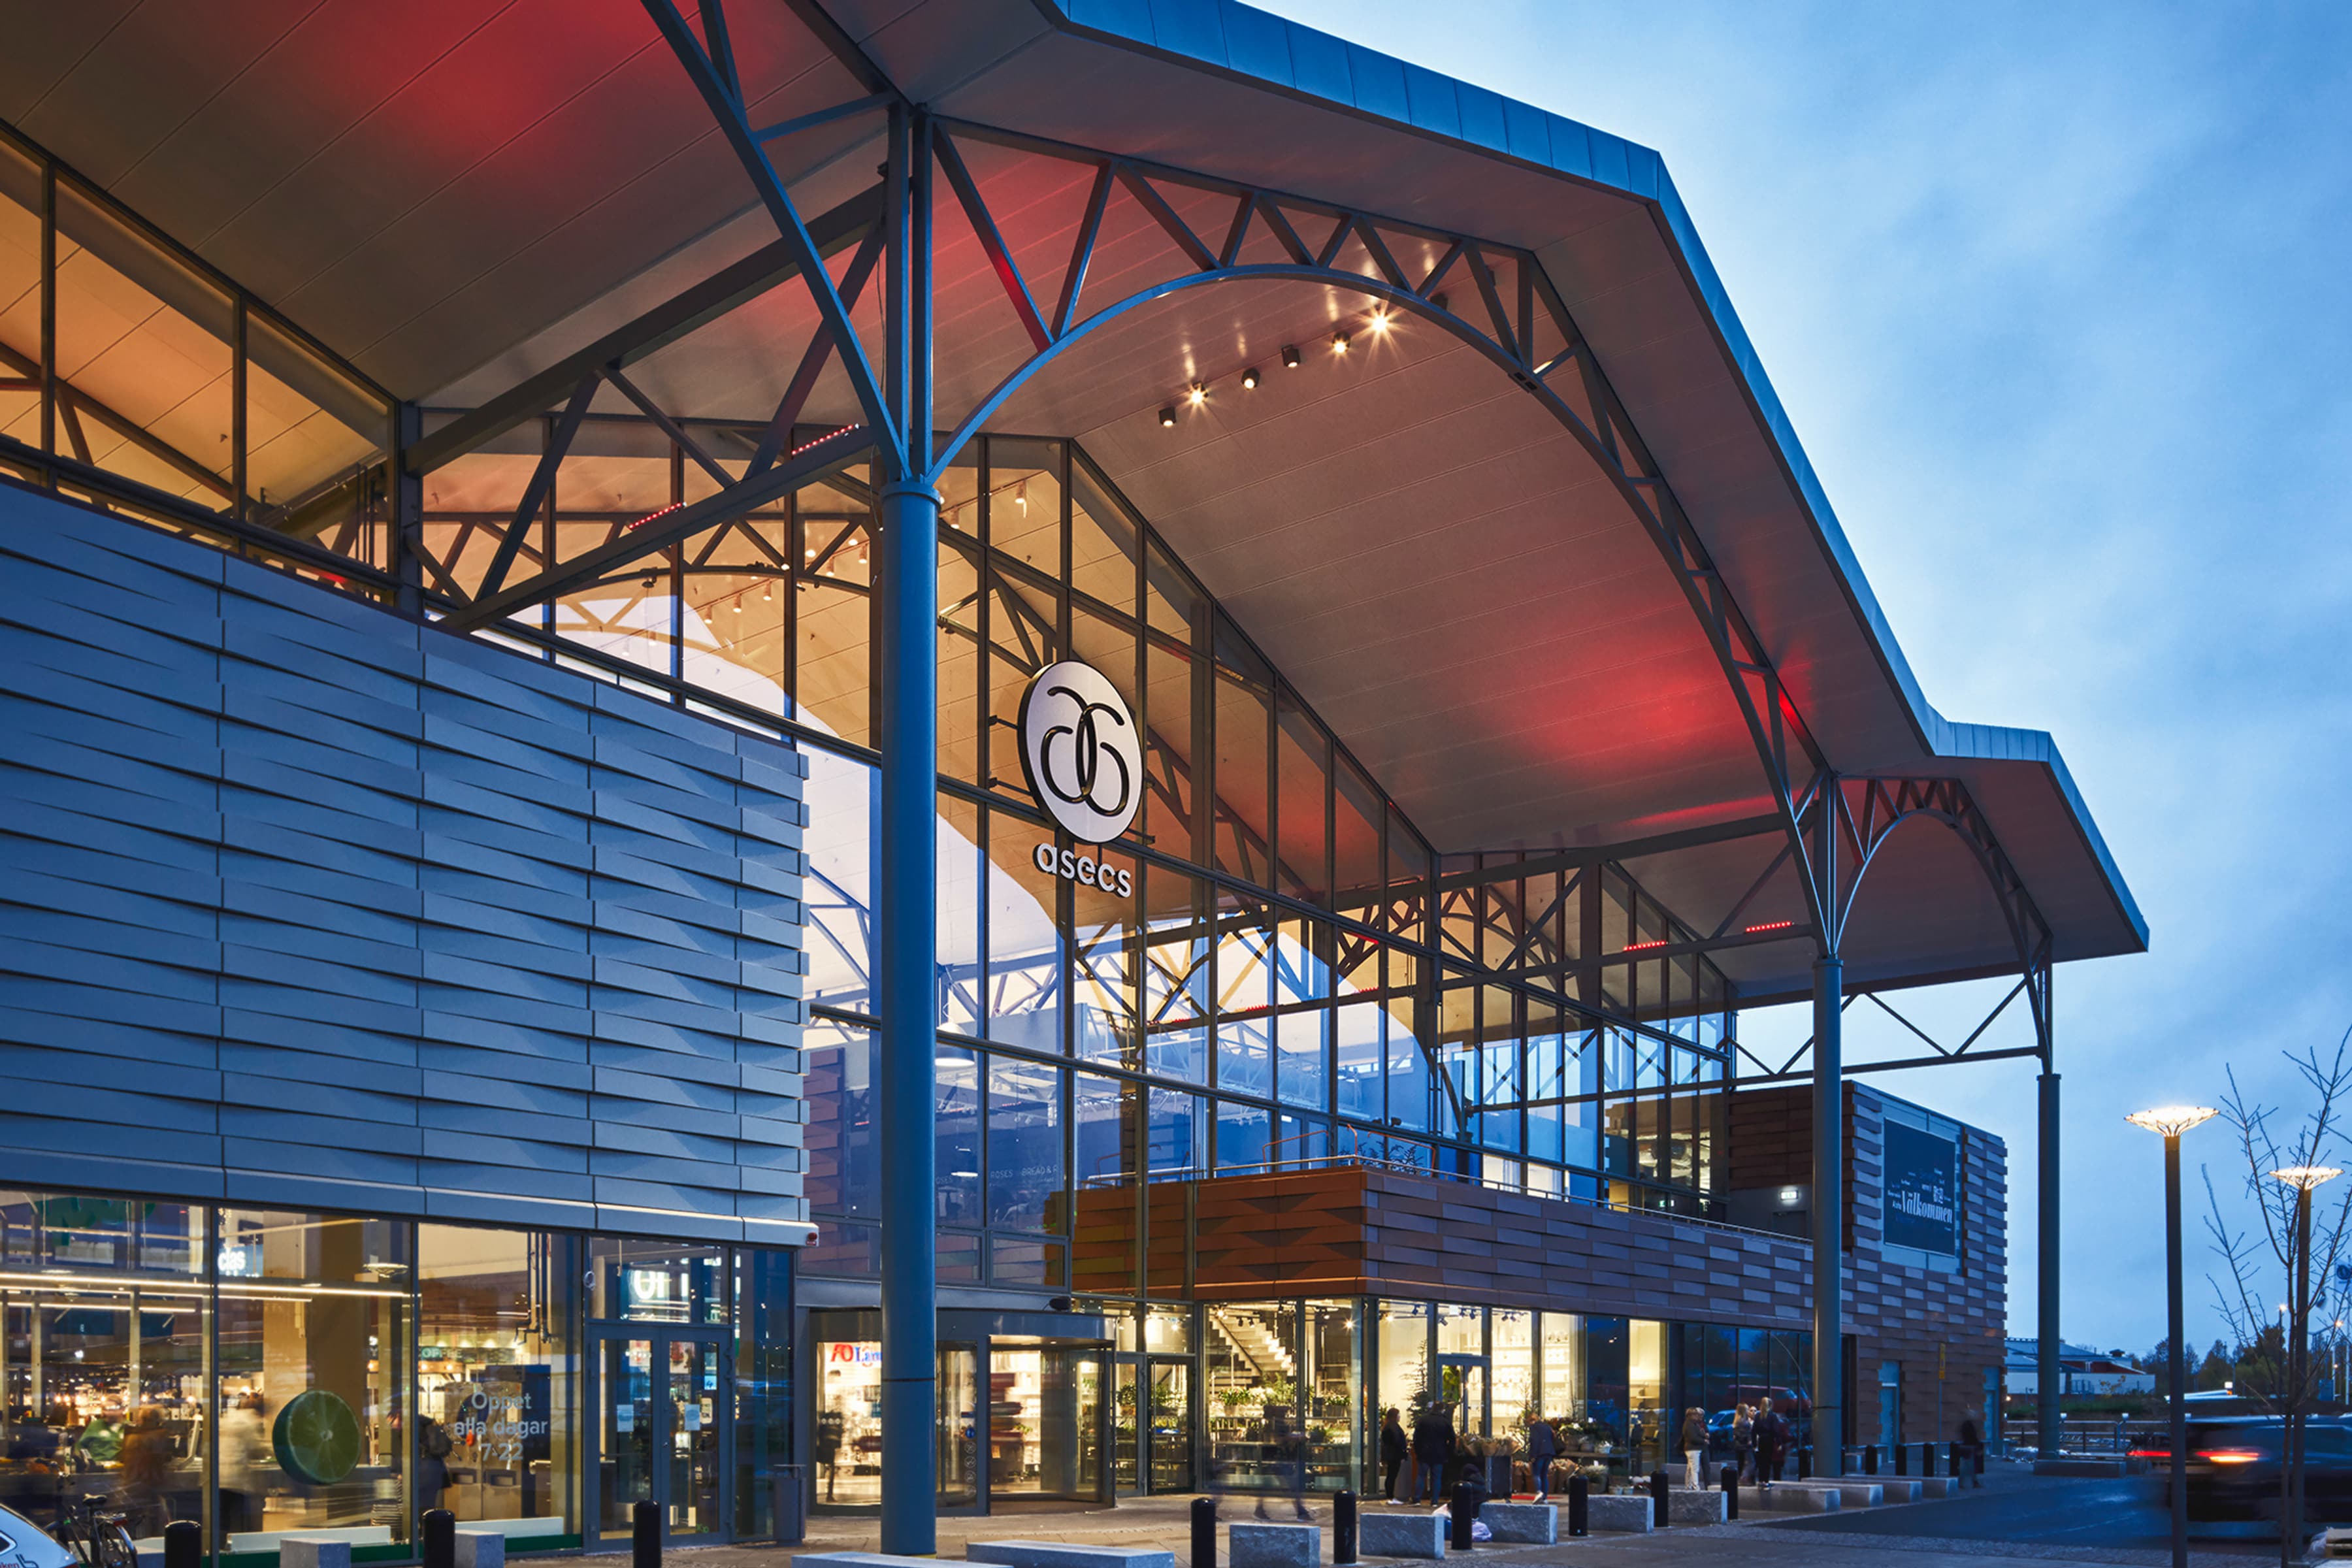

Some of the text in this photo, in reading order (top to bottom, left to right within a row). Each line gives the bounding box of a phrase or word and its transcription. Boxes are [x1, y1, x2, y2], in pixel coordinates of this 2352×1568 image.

[1034, 842, 1132, 898] asecs
[1902, 1190, 1953, 1224] Välkommen
[419, 1347, 463, 1358] OFFEE
[454, 1417, 548, 1440] alla dagar
[481, 1443, 523, 1462] 7-22
